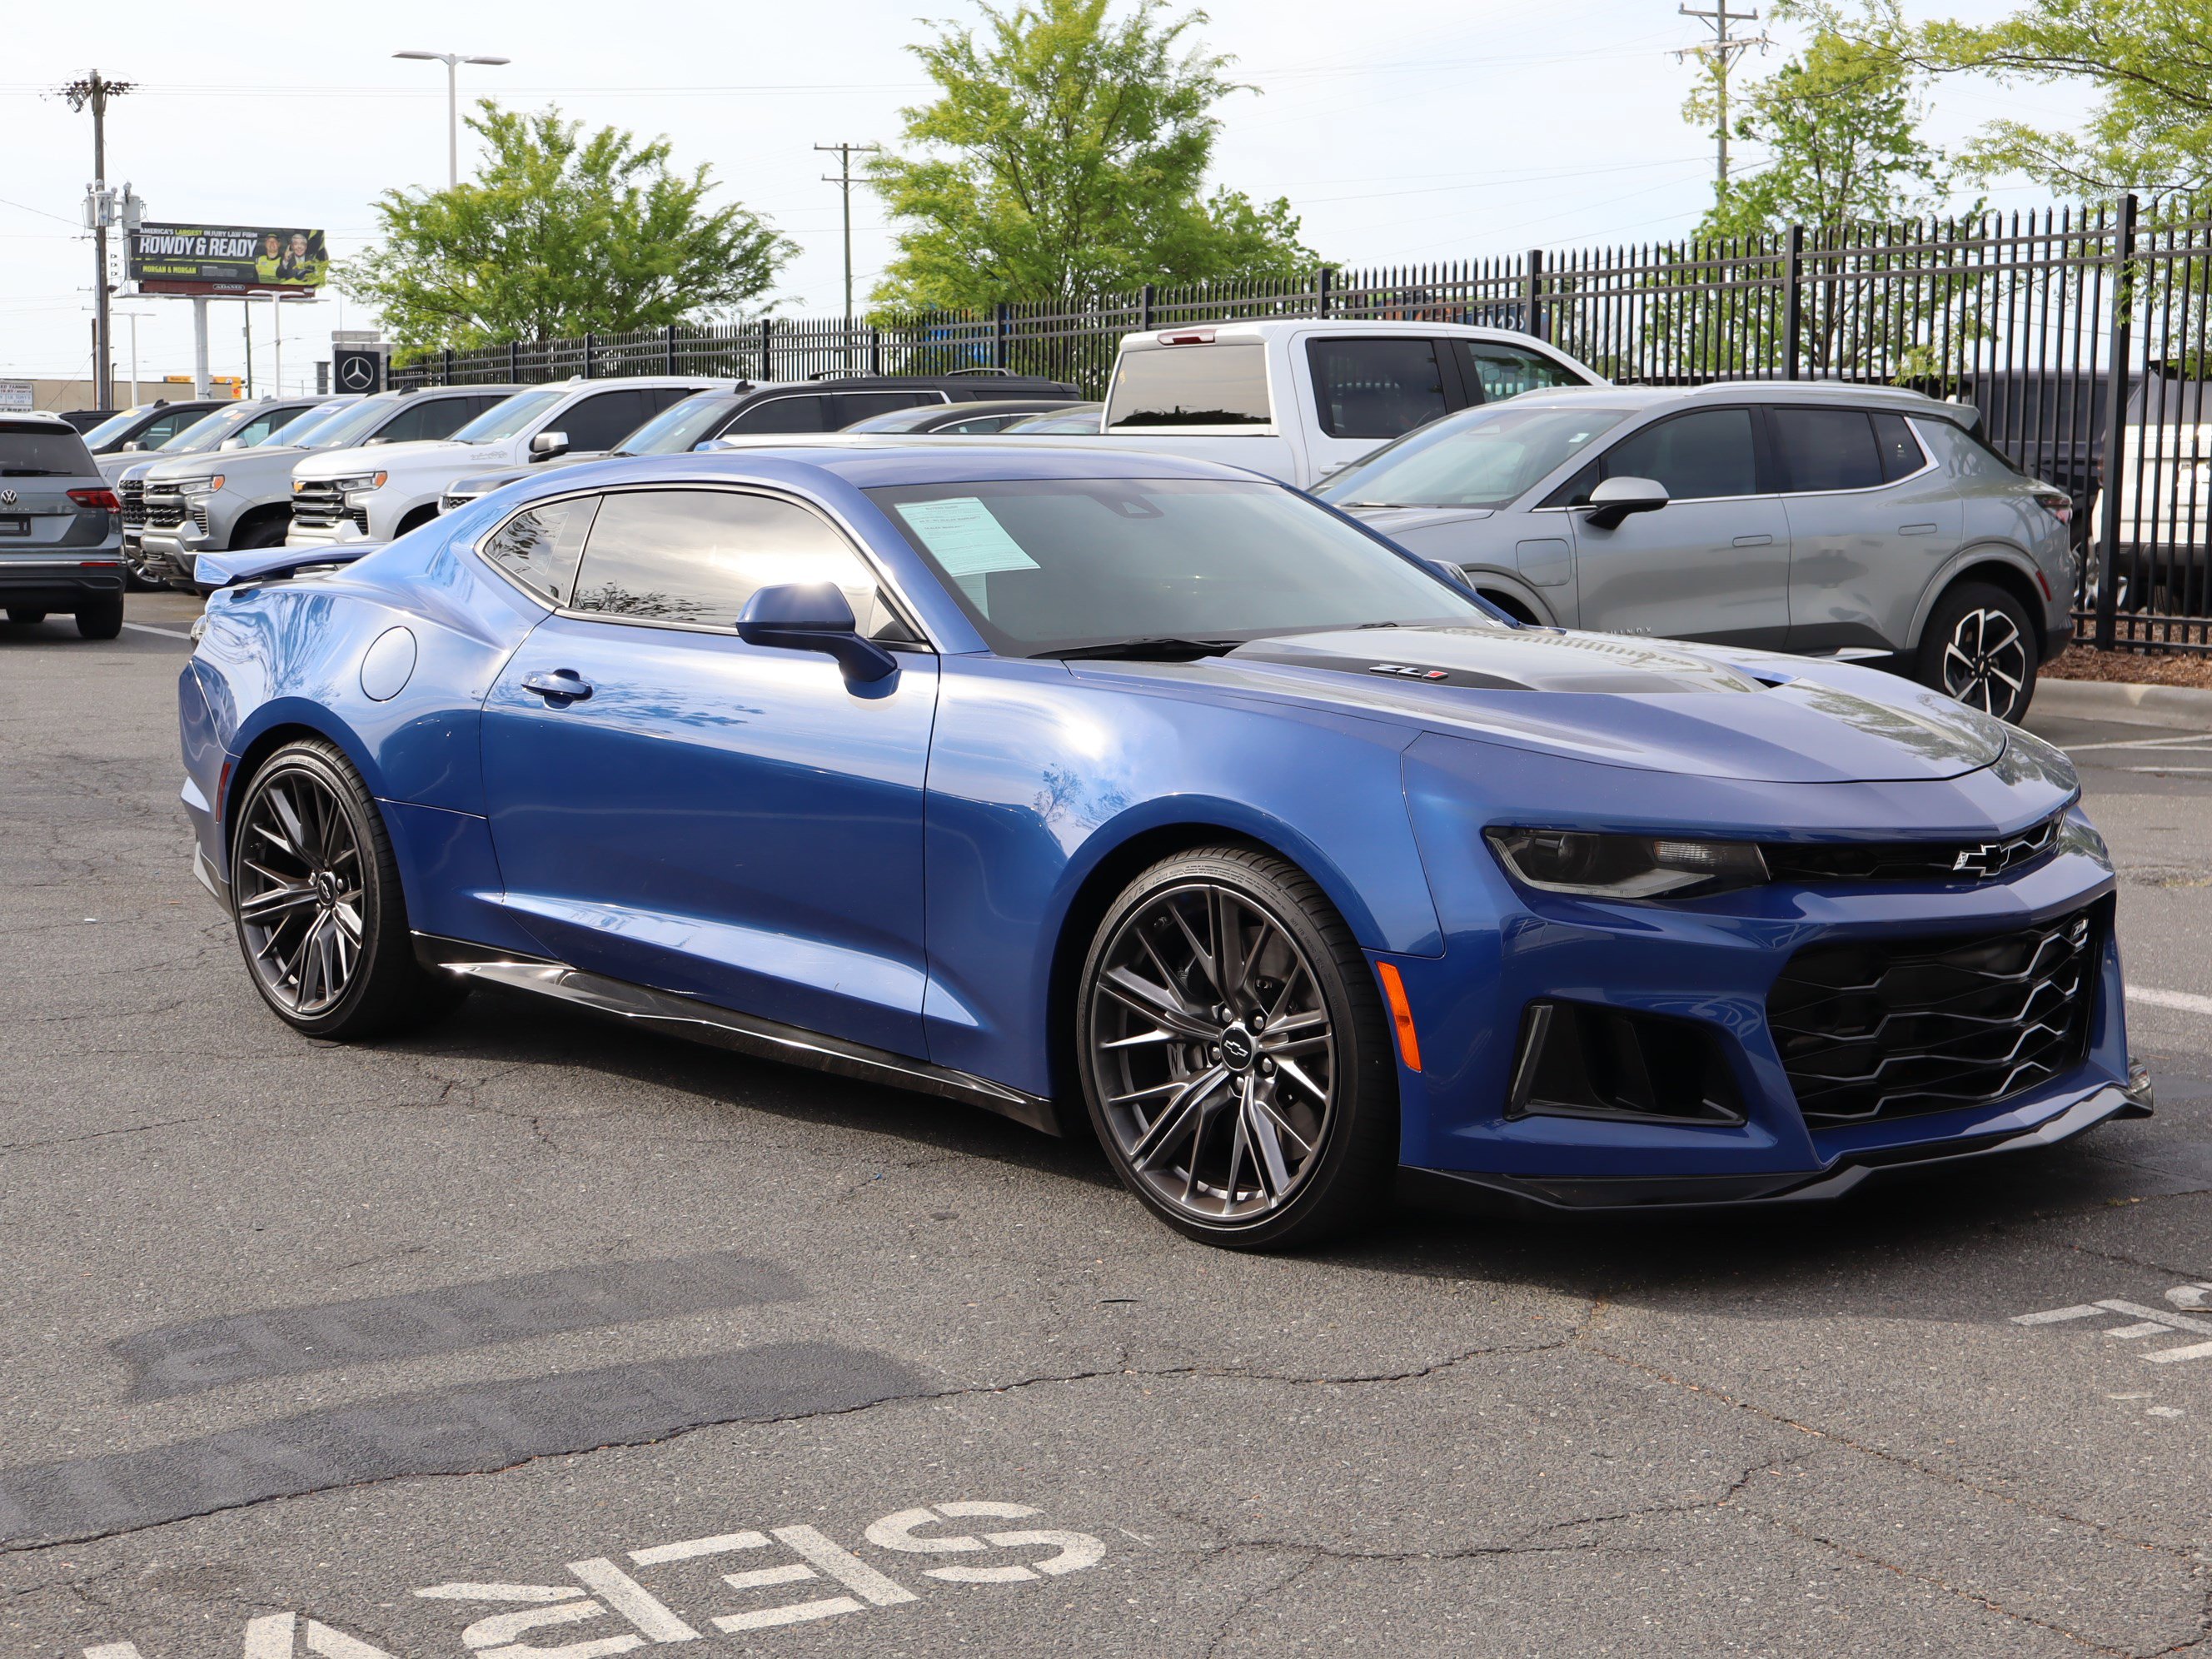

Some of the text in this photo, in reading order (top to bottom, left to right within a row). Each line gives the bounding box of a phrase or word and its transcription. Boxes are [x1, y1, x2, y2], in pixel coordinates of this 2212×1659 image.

[195, 237, 207, 256] &
[208, 238, 258, 257] READY
[142, 265, 167, 273] MORGAN
[1368, 663, 1449, 681] ZL1
